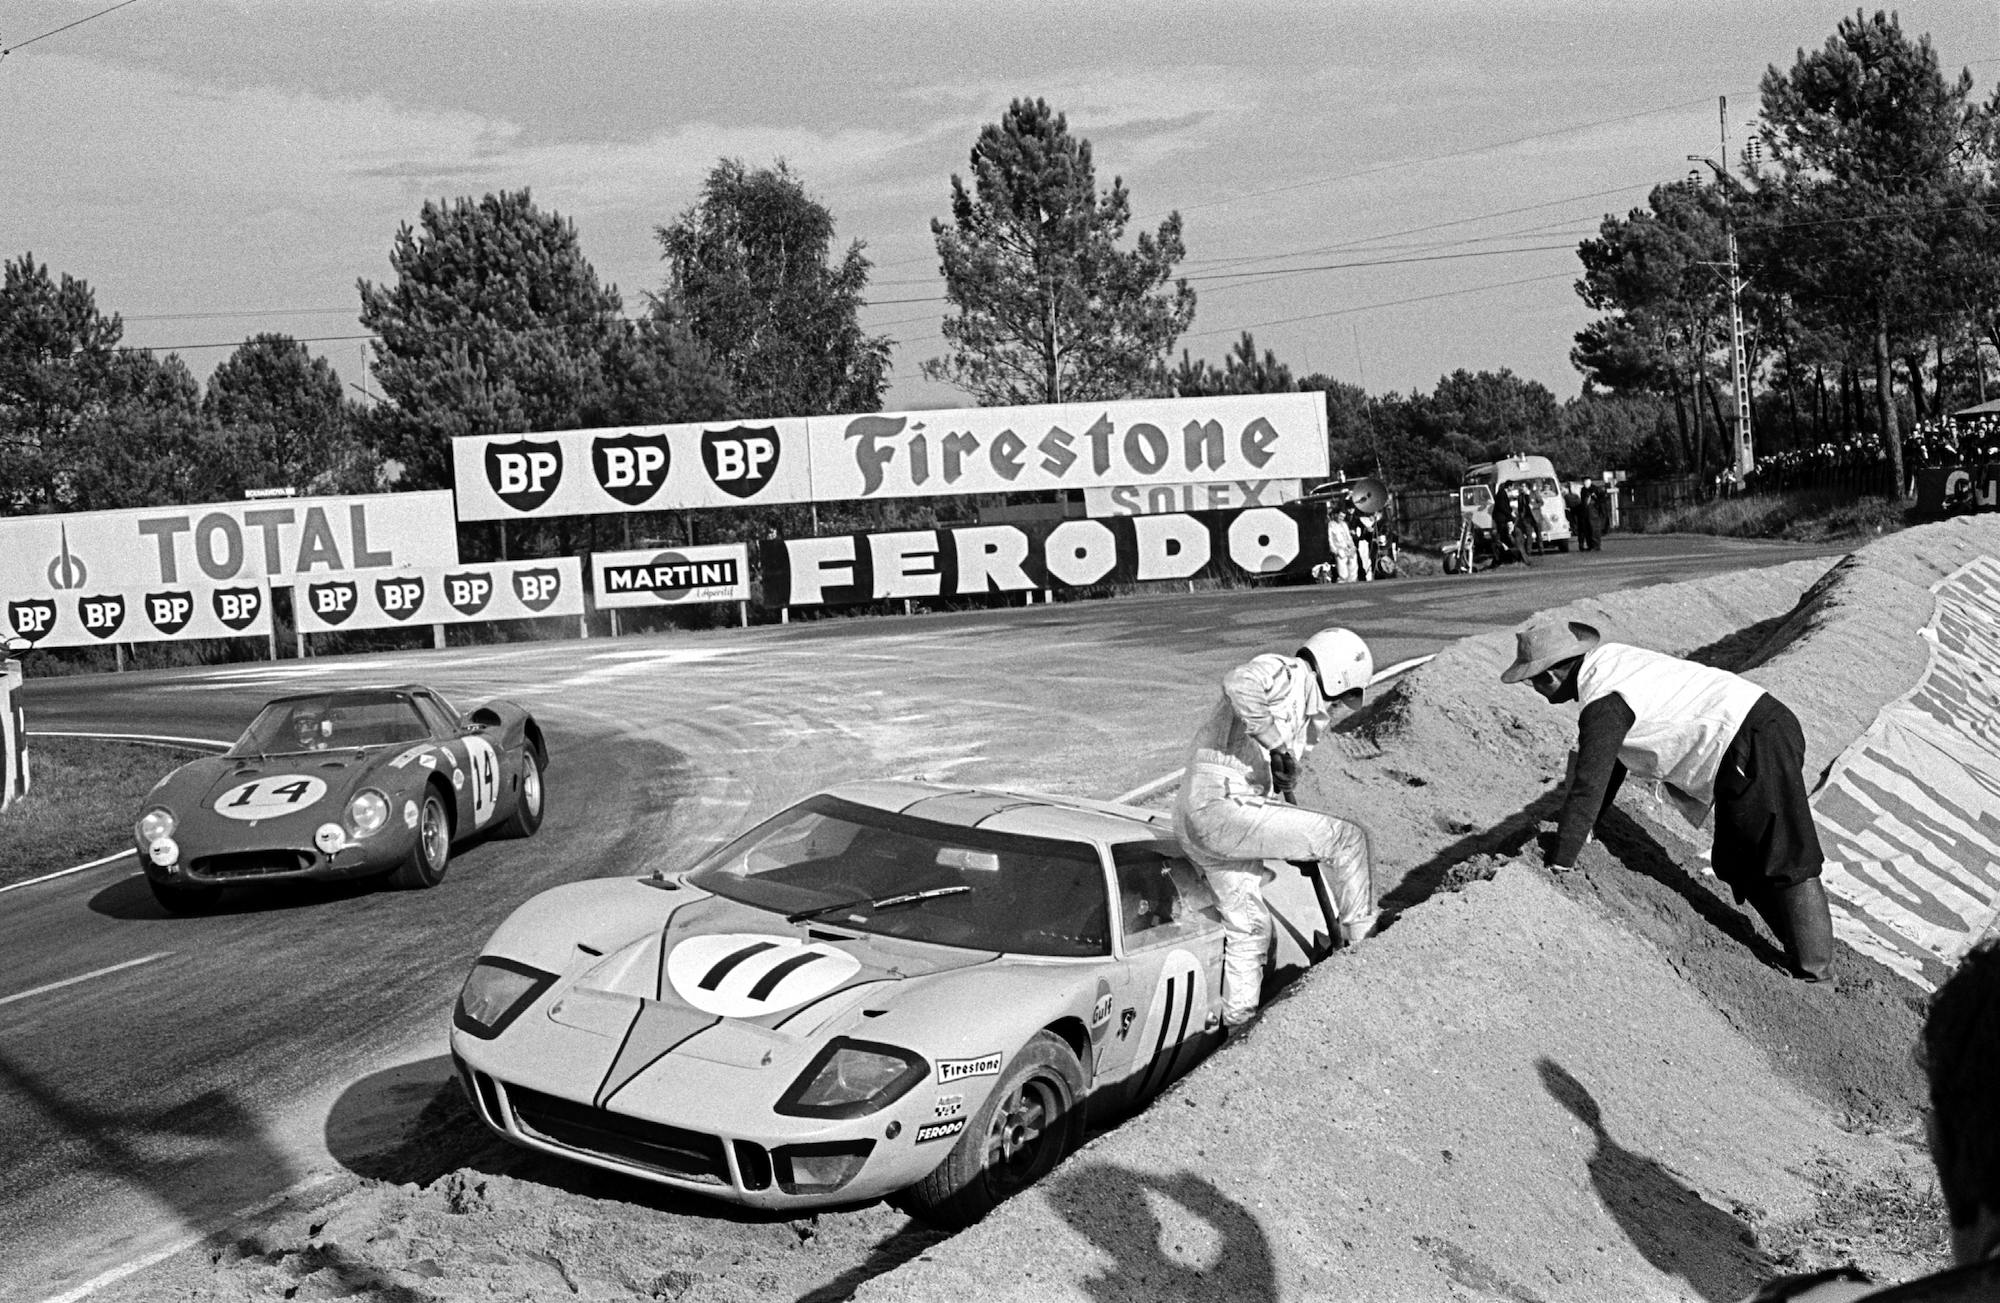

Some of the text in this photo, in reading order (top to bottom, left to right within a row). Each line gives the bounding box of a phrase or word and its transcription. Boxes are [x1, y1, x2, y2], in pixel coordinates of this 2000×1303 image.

[496, 437, 775, 494] BP BP BP
[844, 411, 1279, 496] Firestone
[138, 504, 393, 583] TOTAL
[784, 507, 1300, 605] FERODO
[316, 574, 557, 613] BP BP BP BP
[610, 562, 732, 590] MARTINI
[15, 593, 258, 633] BP BP BP BP
[229, 781, 311, 807] 14
[473, 750, 494, 811] 14
[698, 941, 826, 1002] 11
[1093, 996, 1112, 1025] Gulf
[1136, 969, 1195, 1096] 11
[940, 1059, 999, 1079] Firestone
[917, 1121, 963, 1141] FERODO
